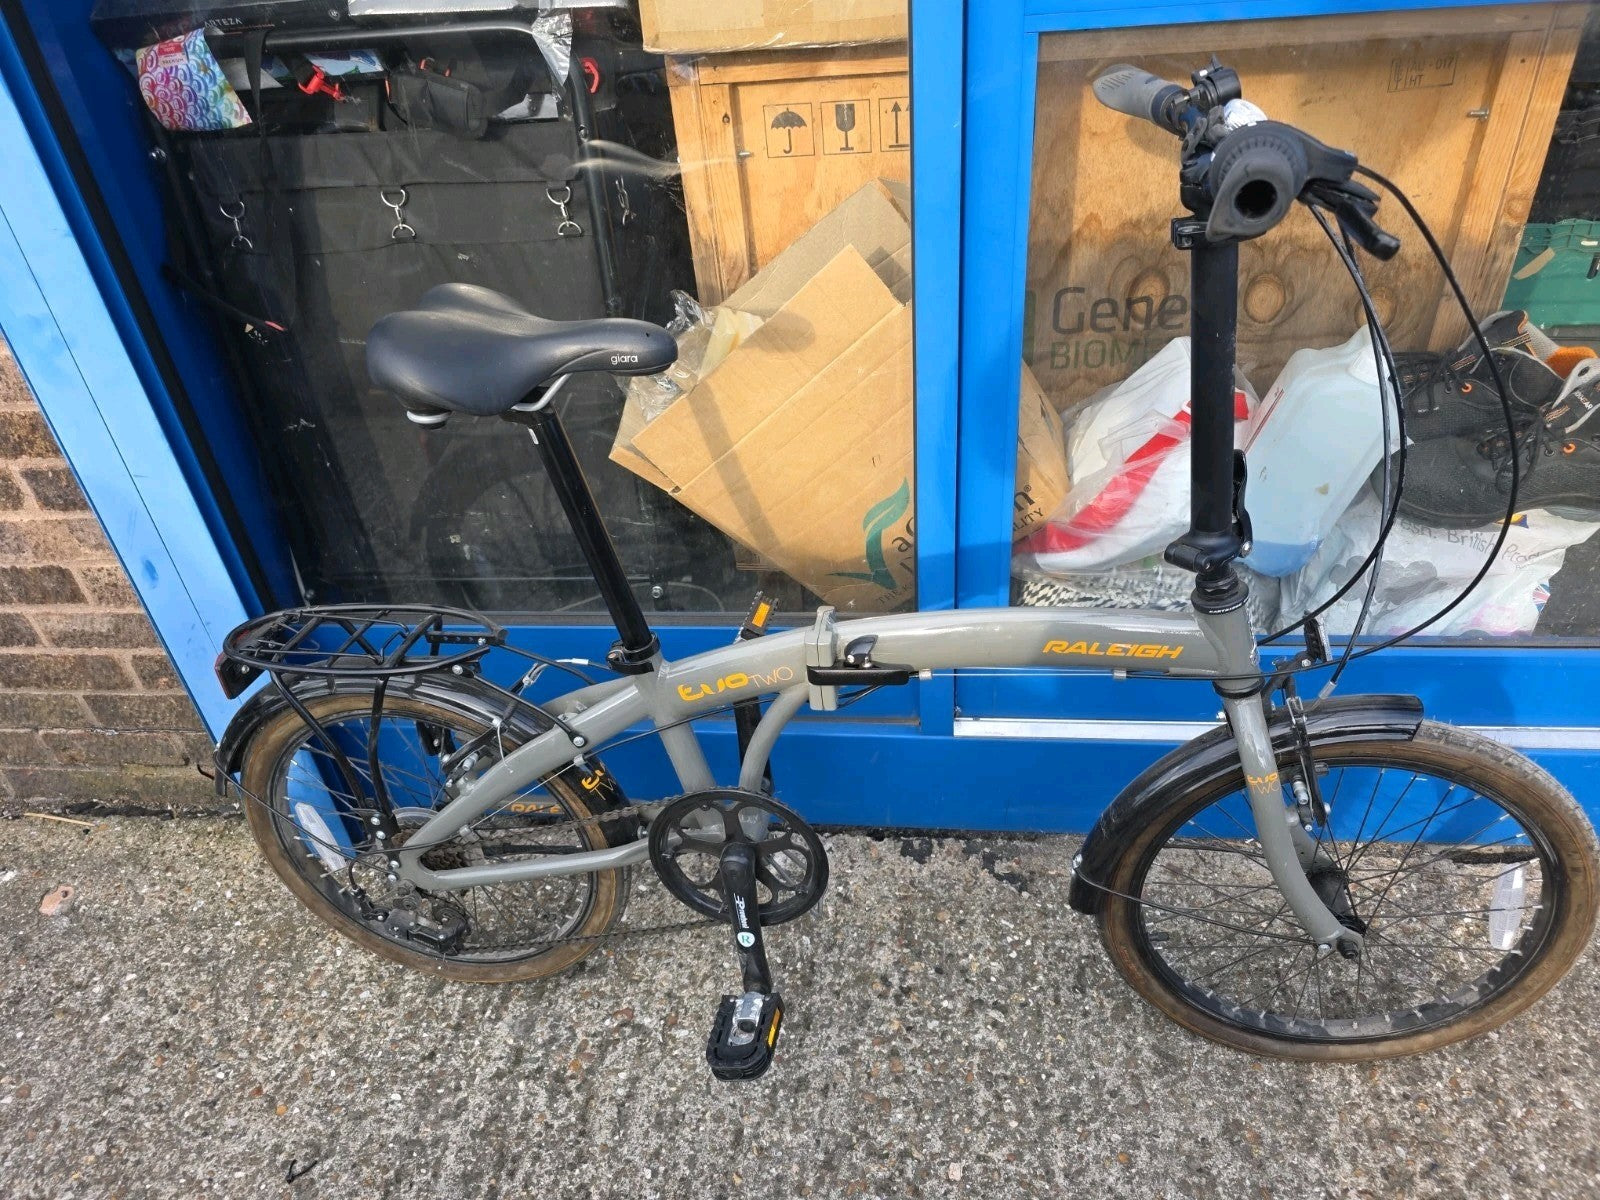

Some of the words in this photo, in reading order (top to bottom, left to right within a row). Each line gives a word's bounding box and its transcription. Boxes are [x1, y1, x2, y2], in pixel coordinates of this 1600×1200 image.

[204, 17, 243, 28] ARTEZA
[610, 353, 639, 366] giara
[1042, 639, 1184, 659] RALEIGH
[741, 934, 751, 945] R
